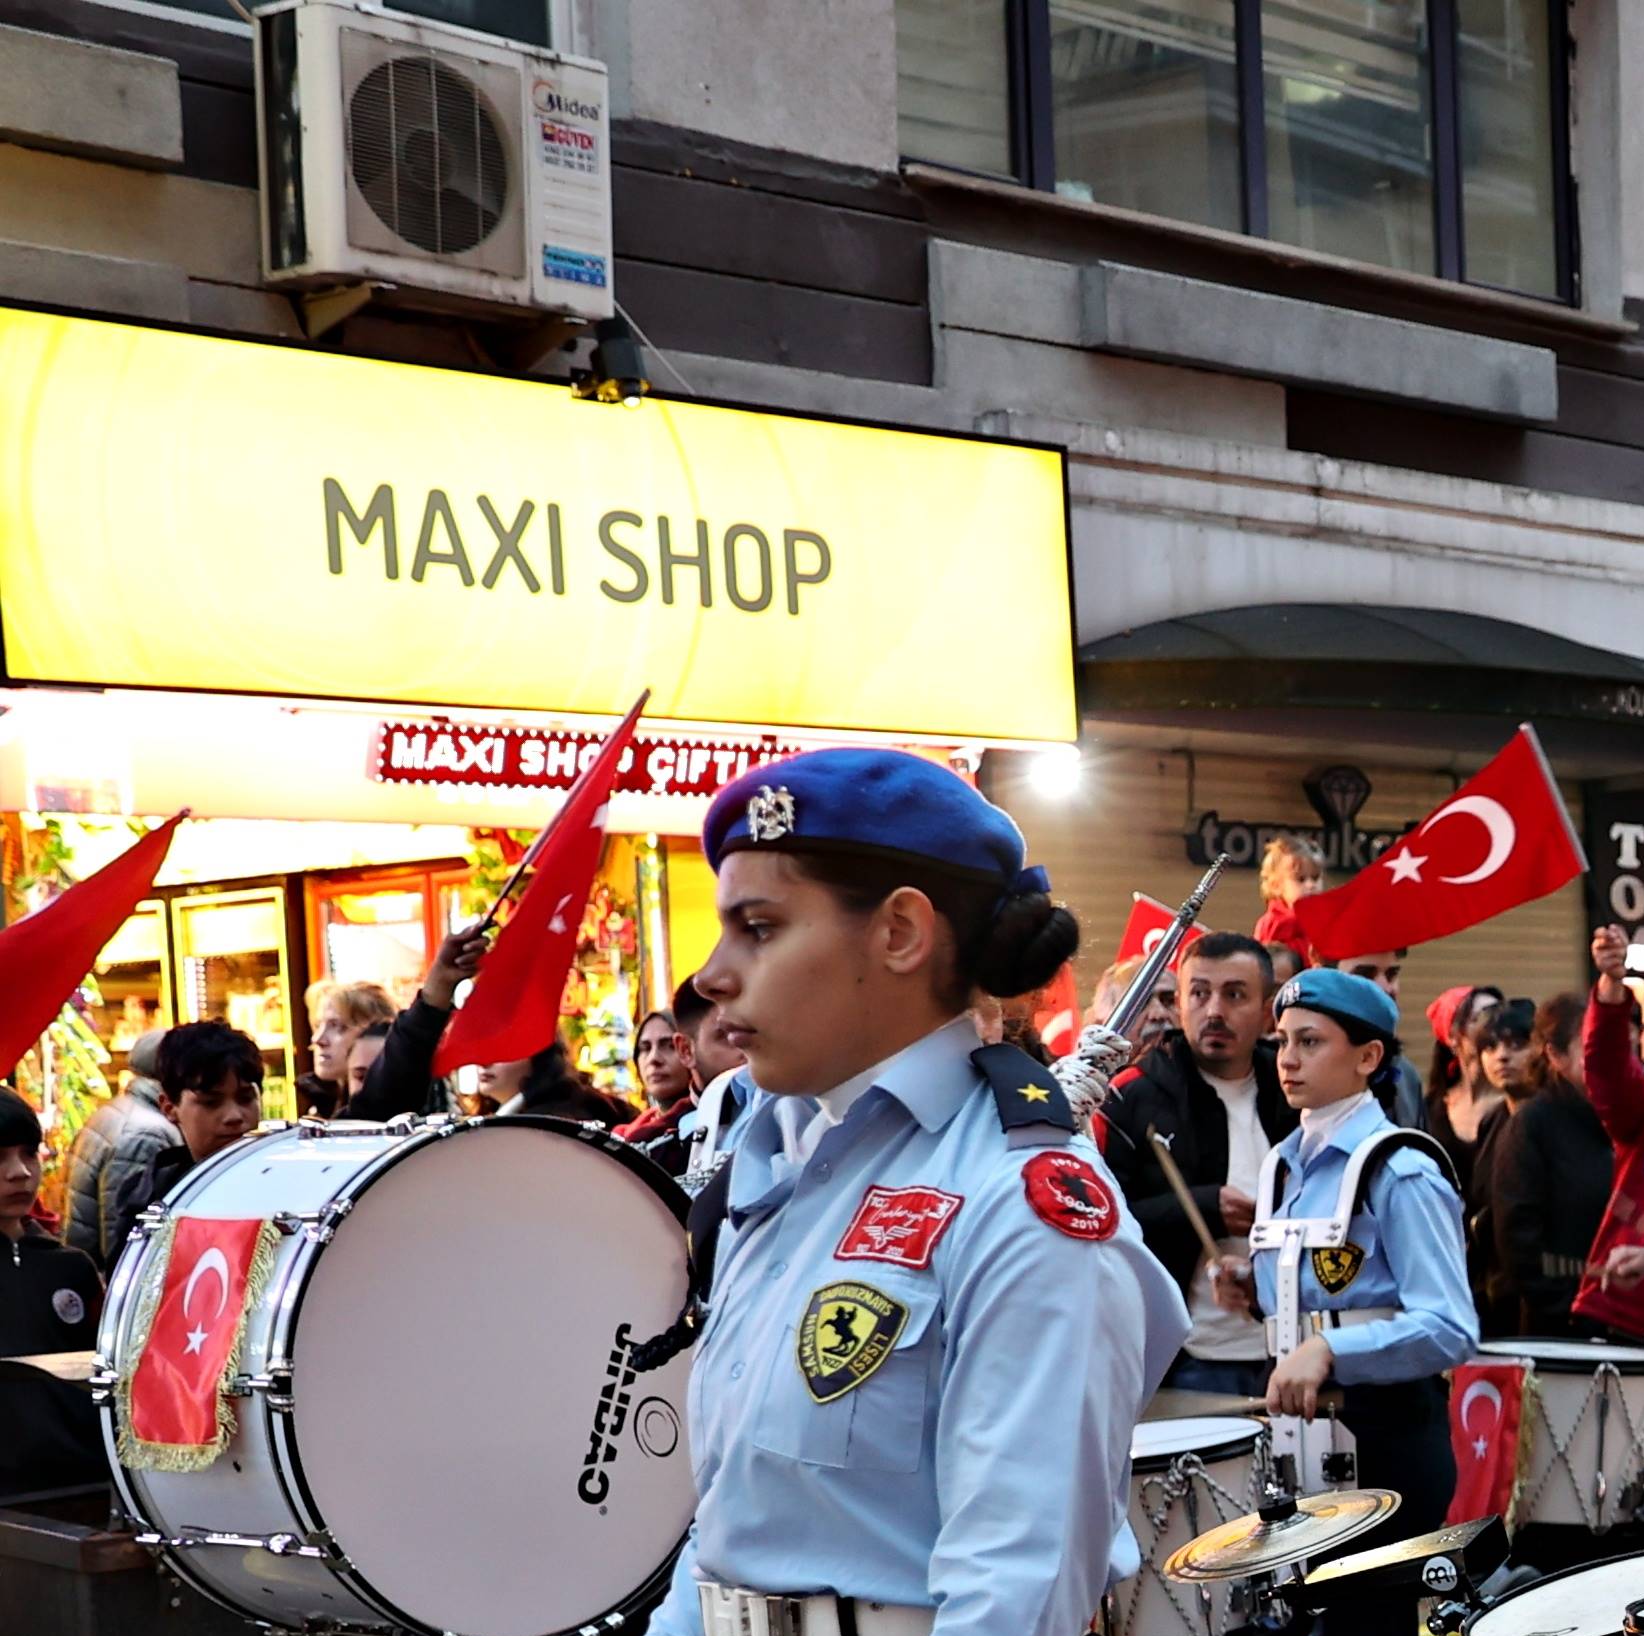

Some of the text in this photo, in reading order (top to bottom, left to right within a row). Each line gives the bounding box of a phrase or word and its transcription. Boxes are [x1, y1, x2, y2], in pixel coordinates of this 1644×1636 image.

[544, 92, 600, 120] Midea
[323, 477, 831, 615] MAXI SHOP
[391, 731, 505, 773] MAXI
[1069, 1218, 1100, 1230] 2019
